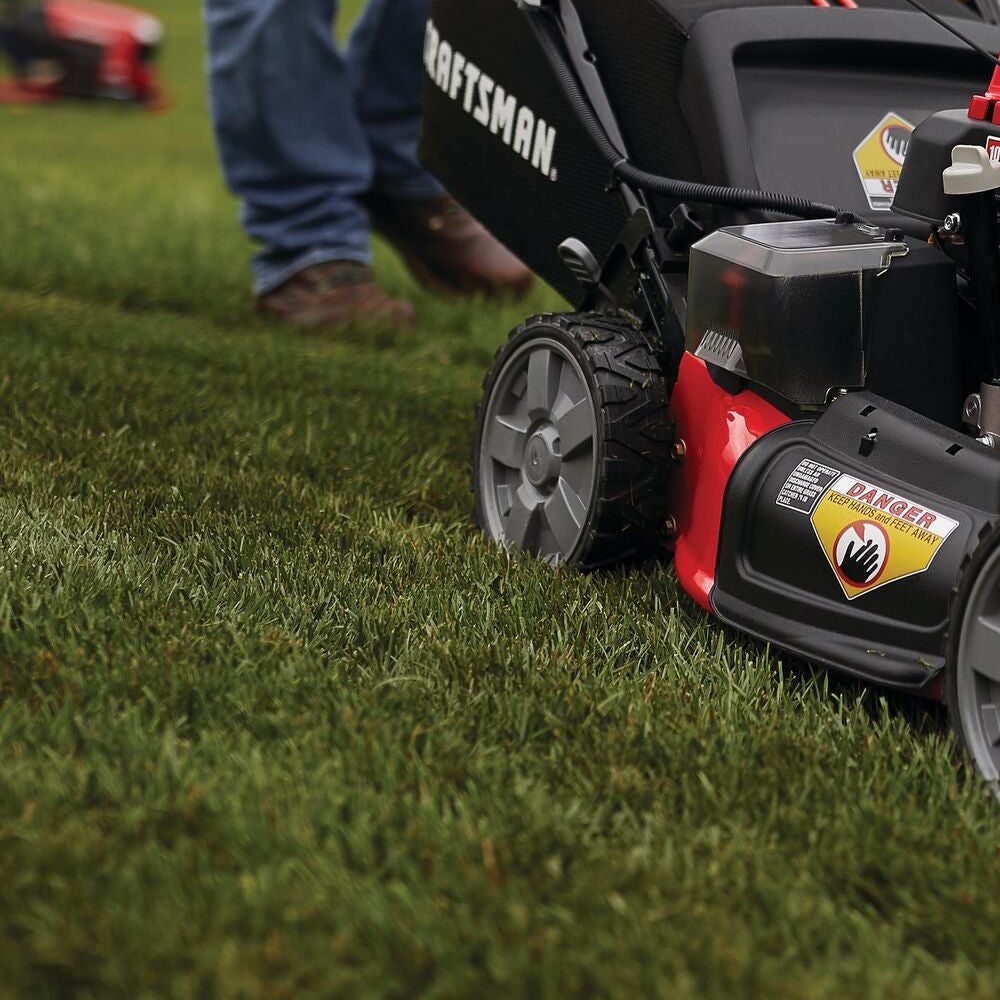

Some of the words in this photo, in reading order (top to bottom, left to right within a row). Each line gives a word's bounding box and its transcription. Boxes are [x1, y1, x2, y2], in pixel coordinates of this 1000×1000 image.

[828, 492, 850, 509] KEEP
[848, 501, 877, 518] HANDS
[874, 514, 892, 525] and
[890, 518, 912, 534] FEET
[912, 526, 940, 546] AWAY
[846, 482, 937, 529] DANGER
